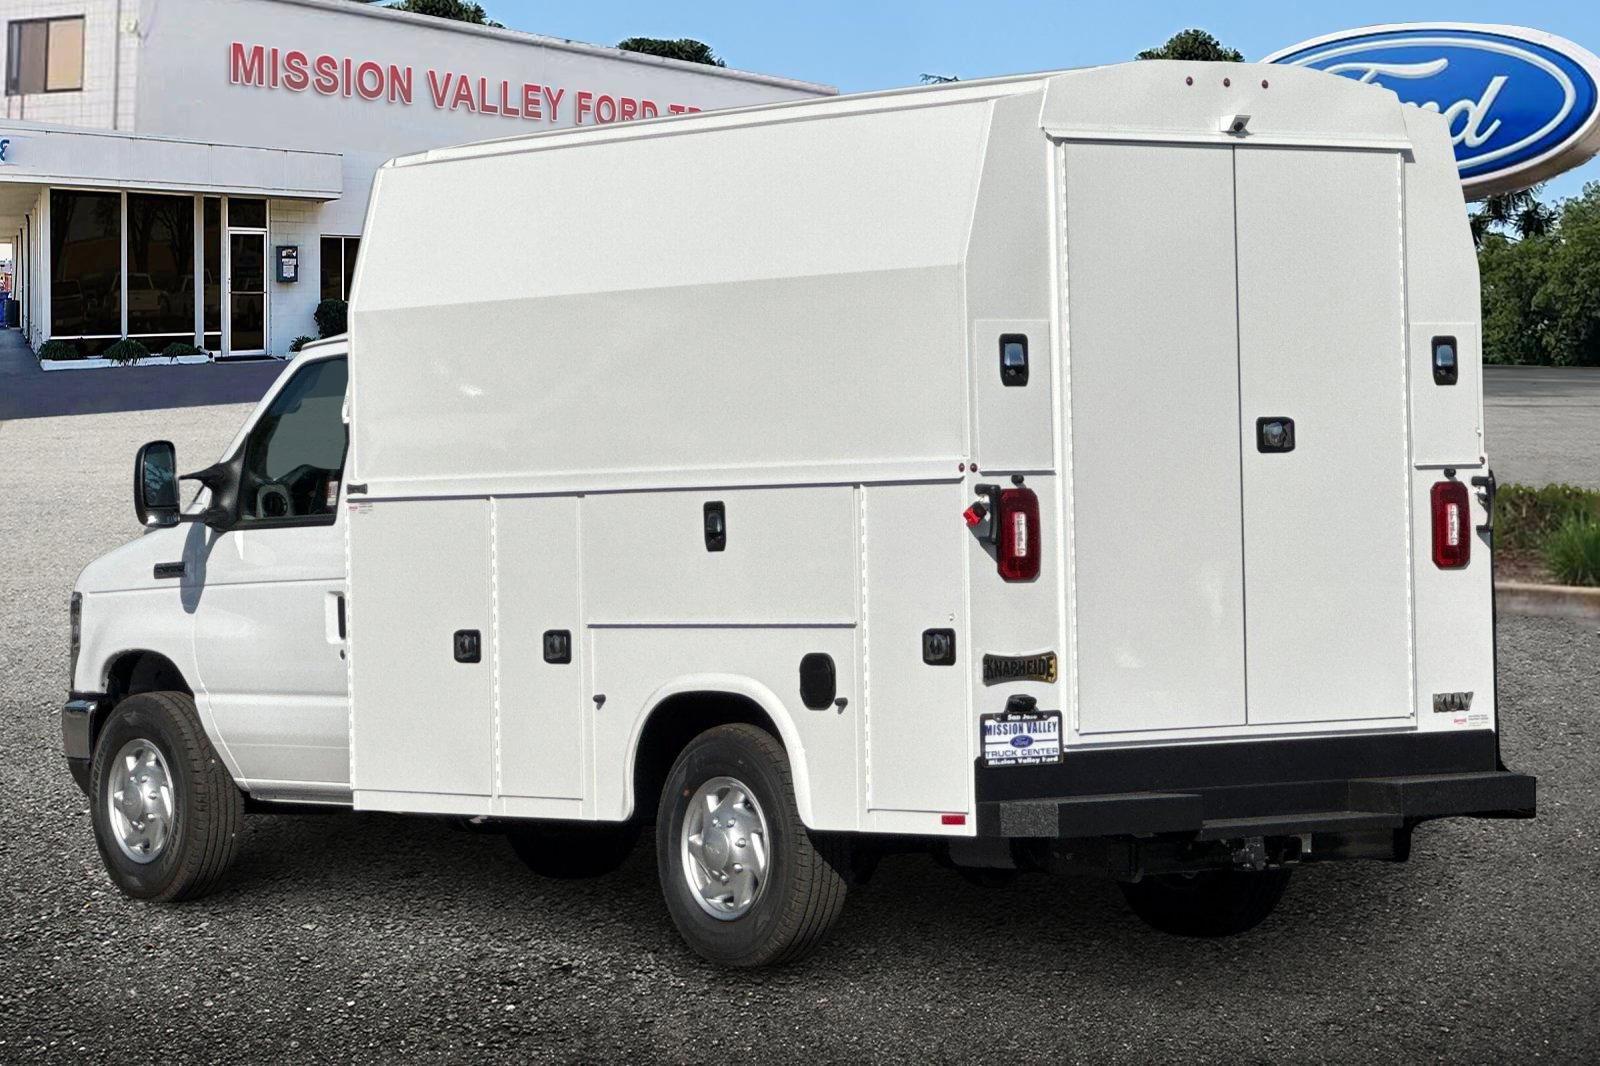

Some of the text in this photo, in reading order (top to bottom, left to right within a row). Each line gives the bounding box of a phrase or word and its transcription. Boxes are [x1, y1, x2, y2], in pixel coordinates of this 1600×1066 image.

[230, 41, 658, 125] MISSION VALLEY FORD
[1433, 692, 1474, 713] KUV
[984, 721, 1057, 736] MISSION VALLEY
[986, 747, 1059, 758] TRUCK CENTER
